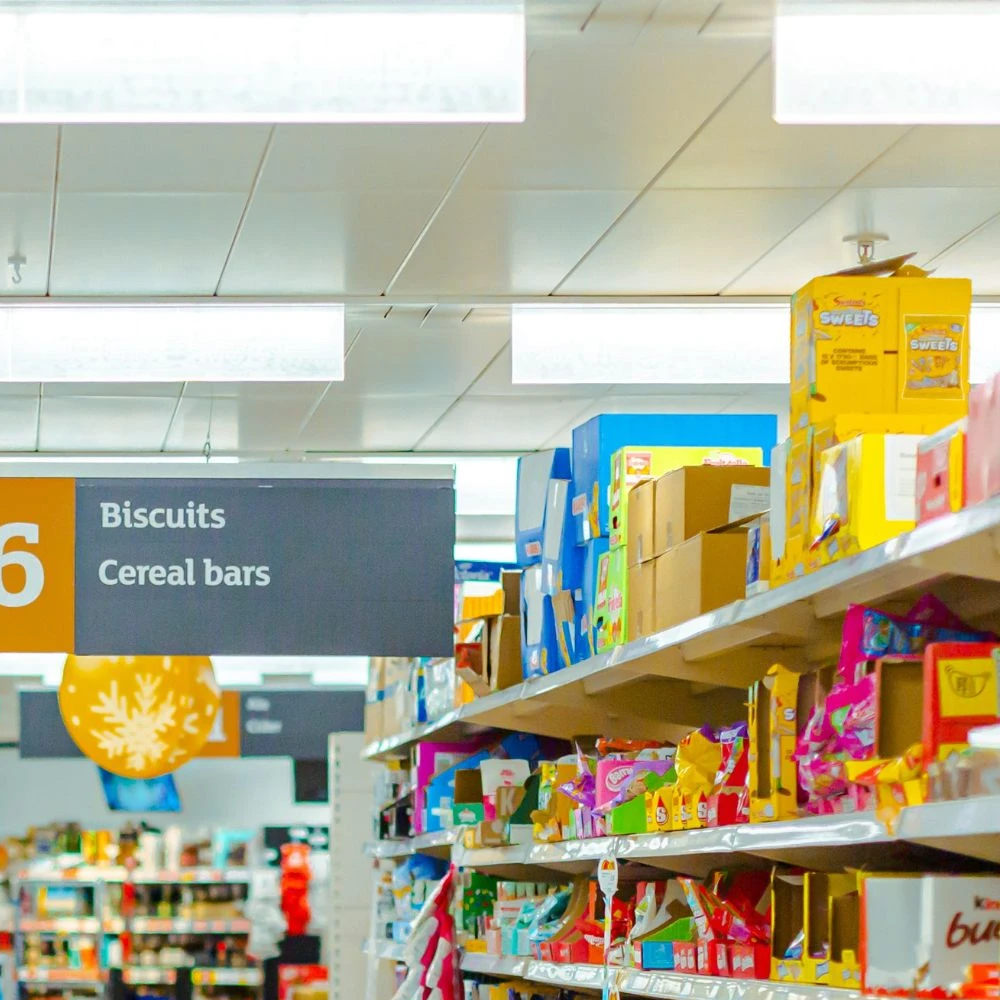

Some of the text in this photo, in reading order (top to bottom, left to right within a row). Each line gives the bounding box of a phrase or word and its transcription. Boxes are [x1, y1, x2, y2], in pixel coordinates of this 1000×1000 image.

[100, 501, 226, 529] Biscuits
[98, 558, 271, 586] Cereal bars
